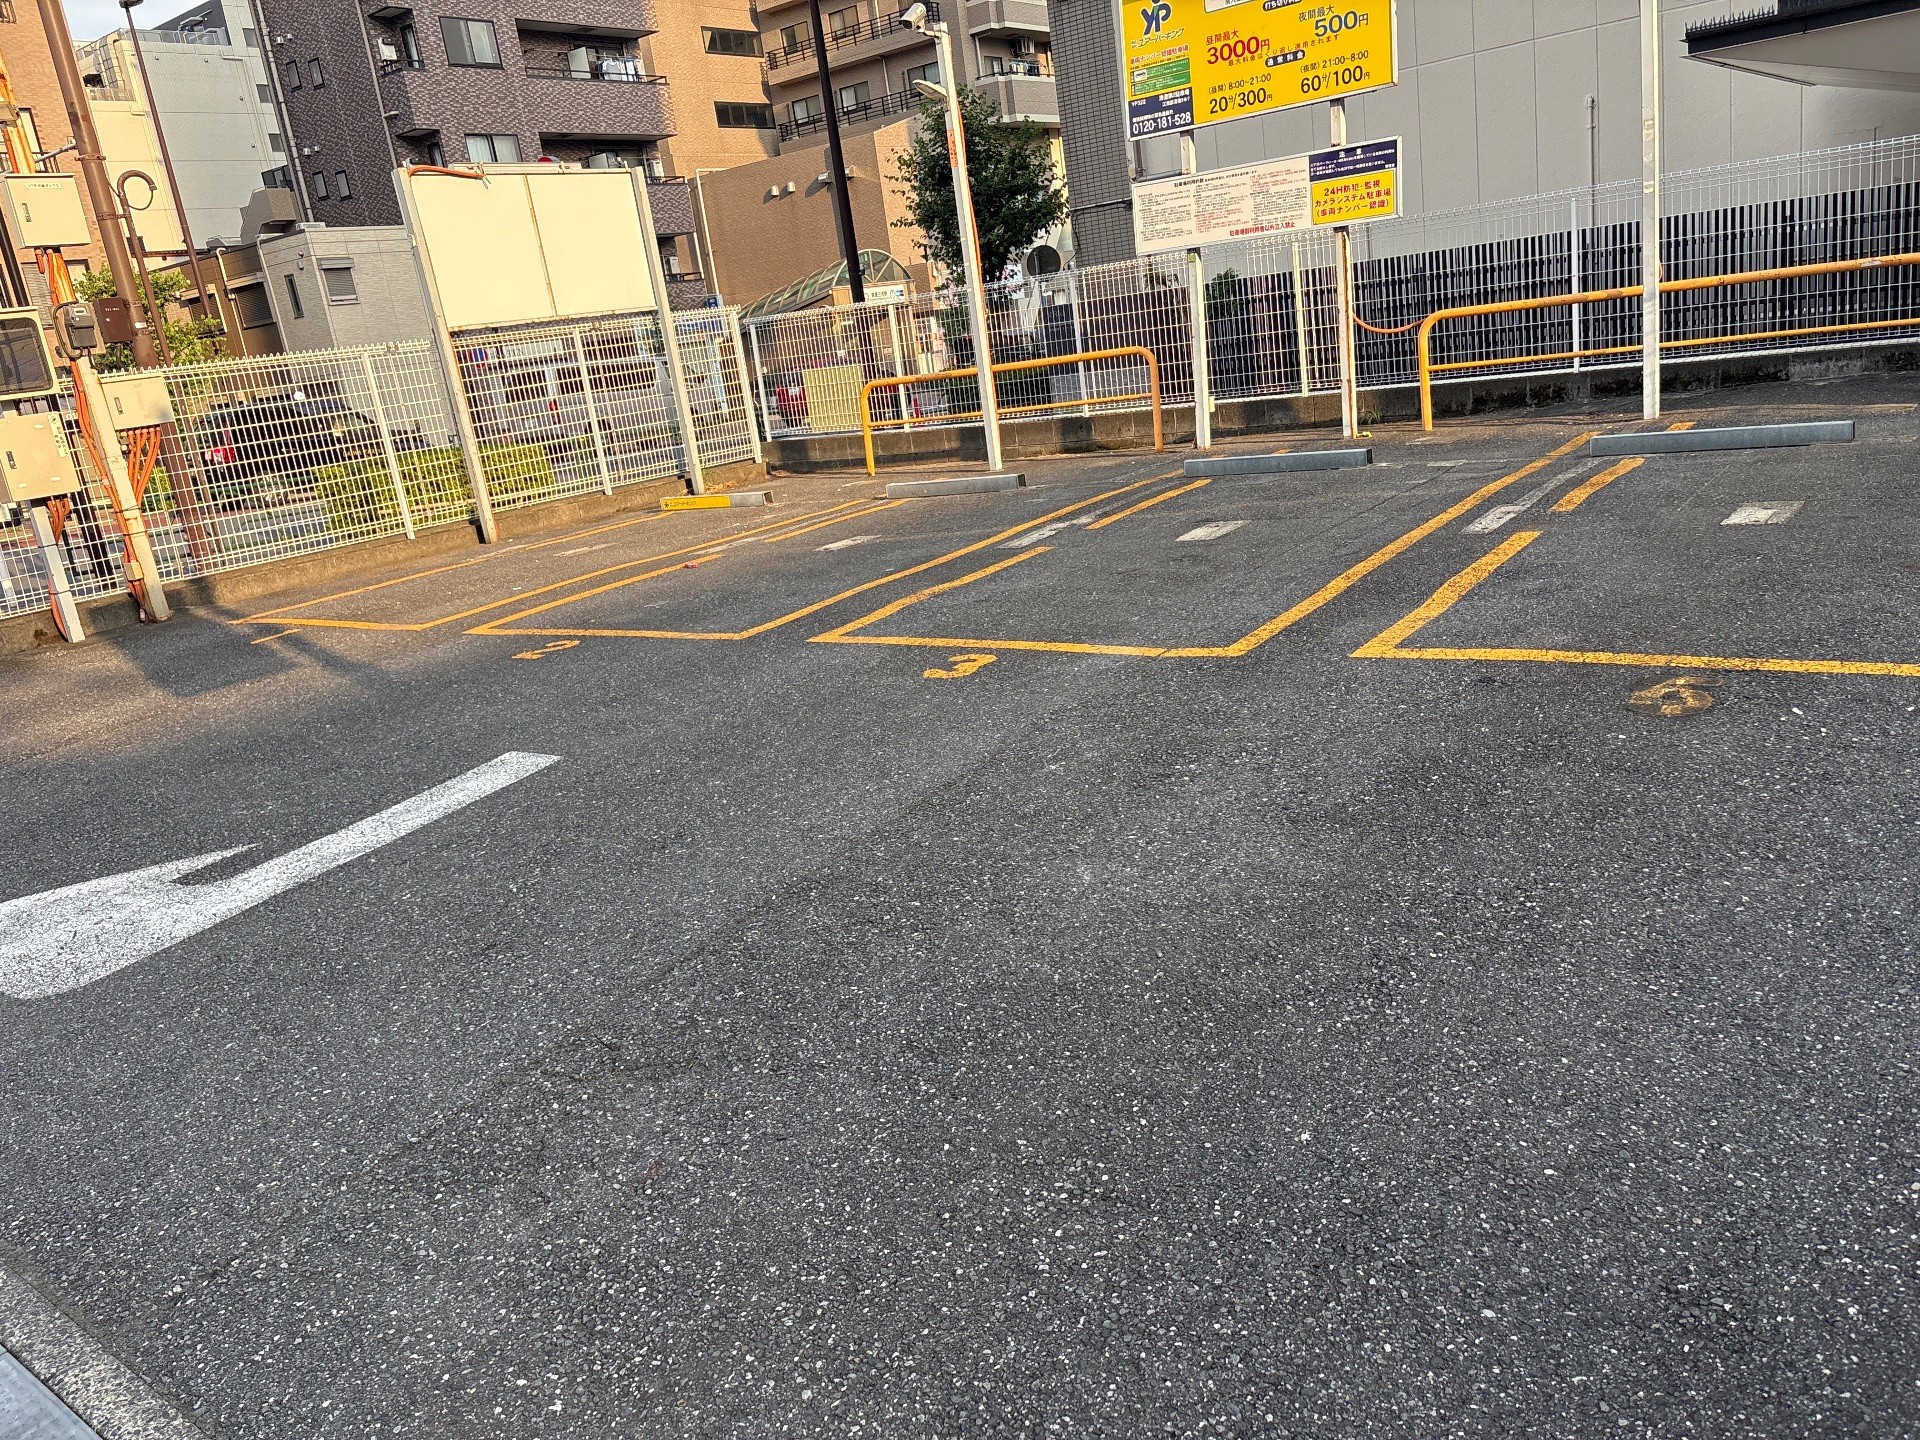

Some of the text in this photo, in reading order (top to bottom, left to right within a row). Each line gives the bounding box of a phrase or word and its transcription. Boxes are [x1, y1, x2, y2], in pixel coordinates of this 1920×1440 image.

[1299, 5, 1335, 22] 夜間最大
[1315, 11, 1369, 37] 500円
[1206, 29, 1239, 45] 昼間最大
[1207, 36, 1270, 64] 3000円
[1133, 112, 1191, 134] 0120-181-528
[1314, 188, 1391, 208] カメラシステム駐車場
[511, 640, 581, 659] 2
[923, 654, 998, 679] 3
